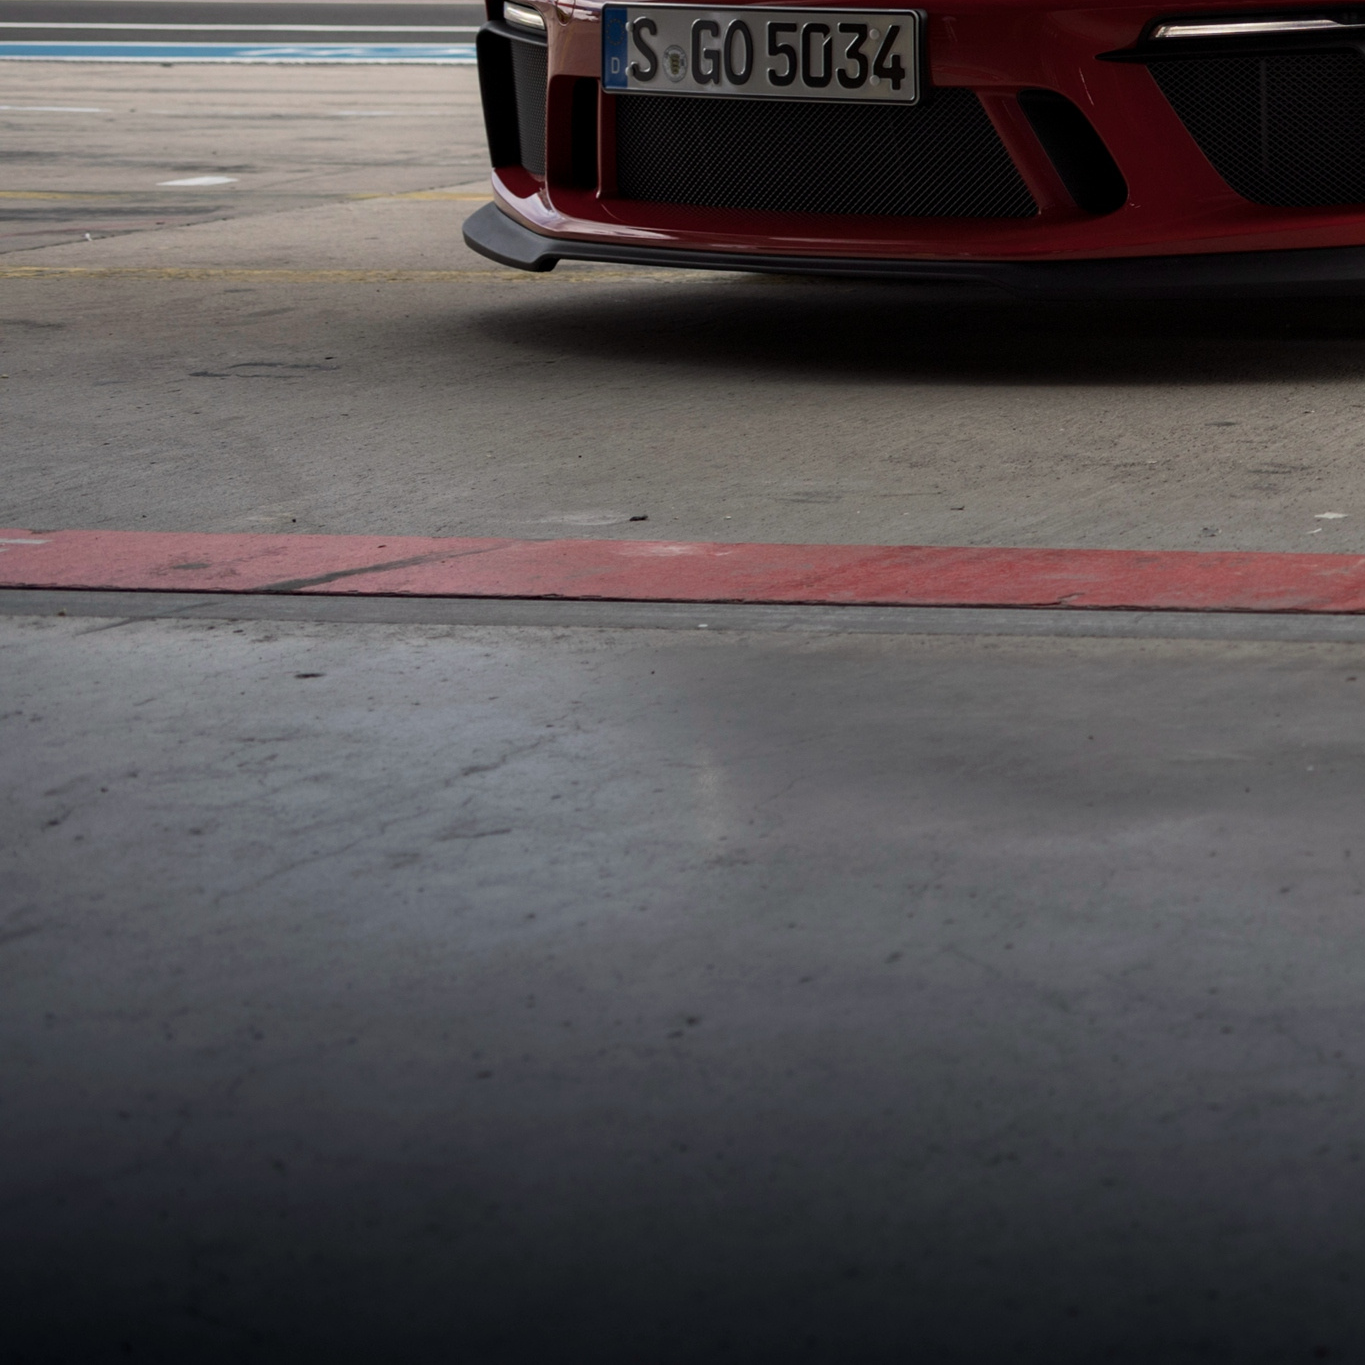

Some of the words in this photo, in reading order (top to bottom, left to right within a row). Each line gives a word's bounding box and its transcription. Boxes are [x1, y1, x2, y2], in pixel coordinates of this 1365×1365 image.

[610, 57, 621, 74] D
[631, 17, 658, 83] S
[691, 18, 753, 86] GO
[766, 22, 906, 91] 5034
